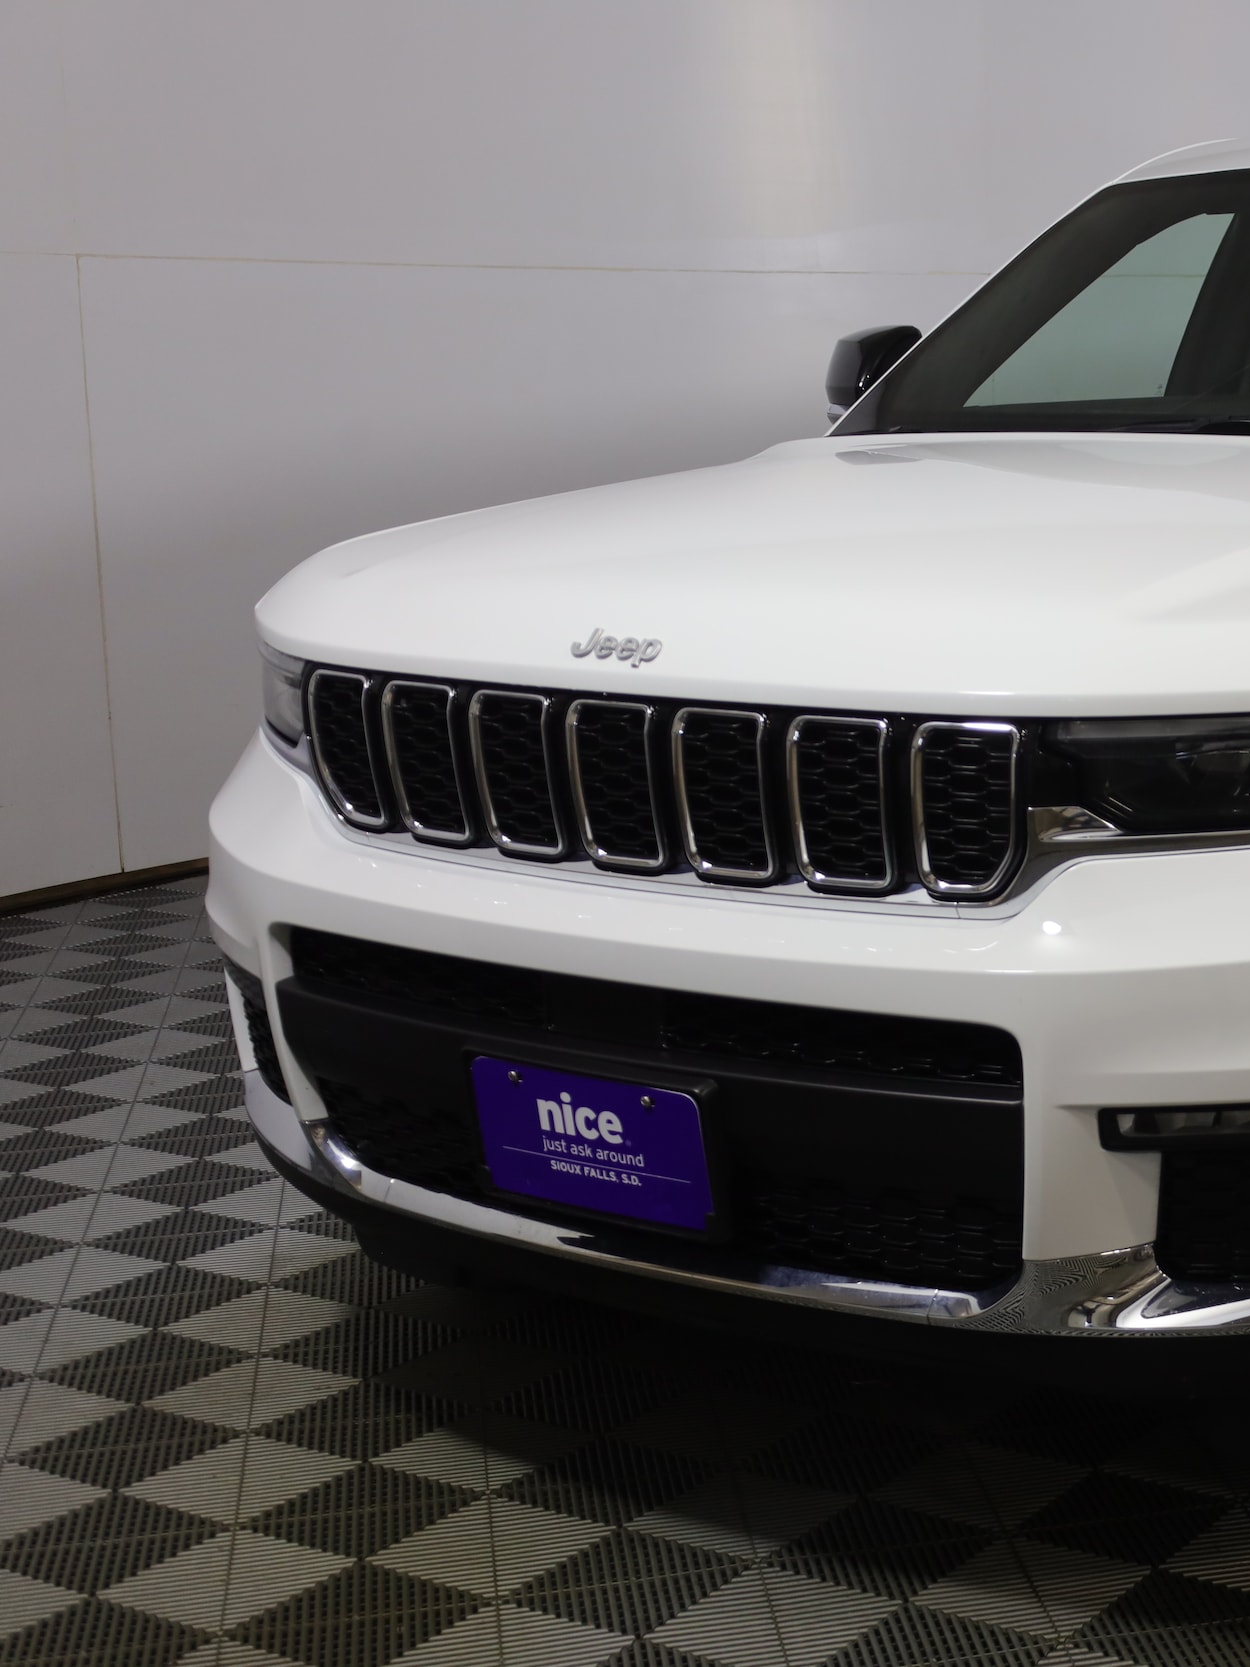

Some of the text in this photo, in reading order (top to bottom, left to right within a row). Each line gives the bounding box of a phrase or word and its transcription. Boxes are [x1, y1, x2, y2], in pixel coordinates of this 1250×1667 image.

[570, 627, 663, 668] Jeep
[536, 1092, 624, 1144] nice
[542, 1135, 645, 1167] just ask around
[550, 1160, 582, 1176] SIOUX
[621, 1174, 642, 1186] S.D.
